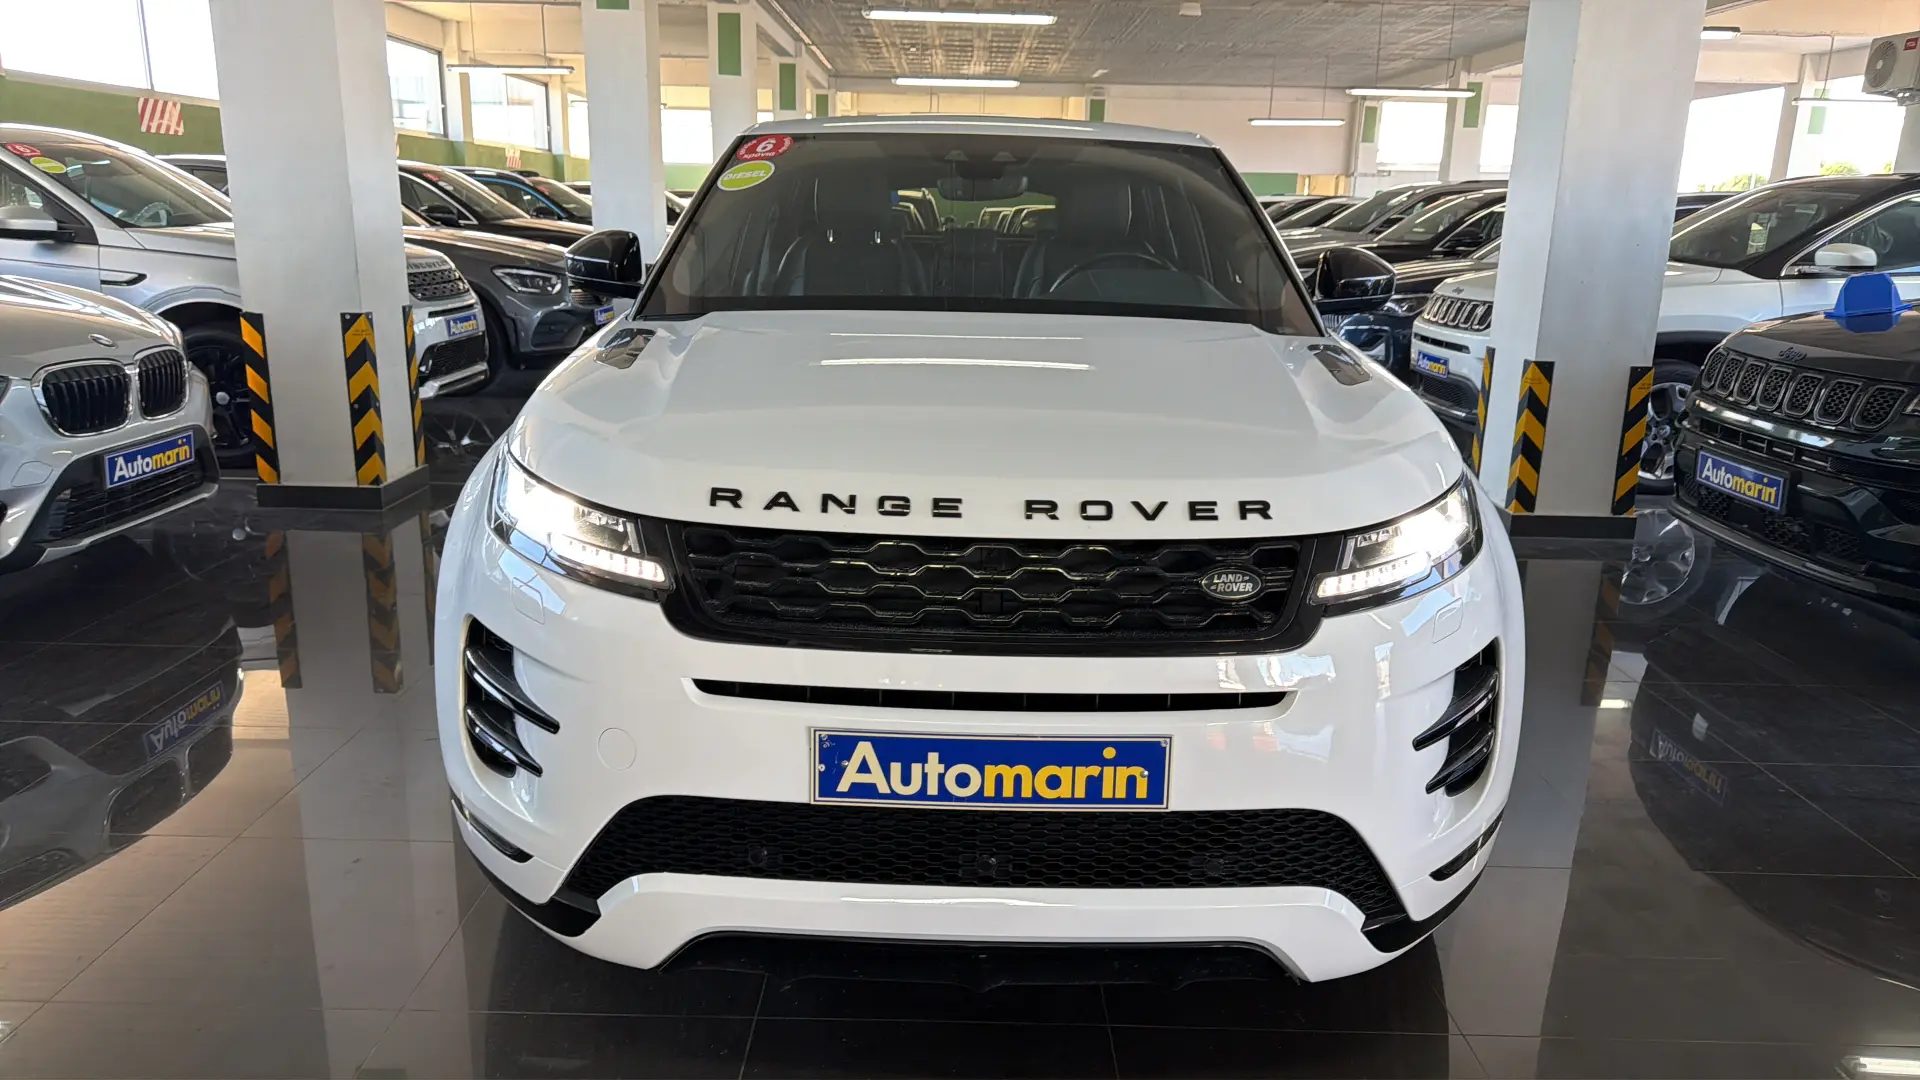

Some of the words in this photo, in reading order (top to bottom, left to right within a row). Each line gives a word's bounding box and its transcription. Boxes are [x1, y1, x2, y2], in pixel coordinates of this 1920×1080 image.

[756, 139, 776, 152] 6
[723, 170, 766, 180] DIESEL
[113, 439, 190, 482] Automarin
[1701, 457, 1777, 504] Automarin
[709, 487, 963, 518] RANGE
[1024, 499, 1273, 521] ROVER
[1213, 574, 1243, 583] LAND
[1216, 582, 1254, 592] ROVER
[836, 740, 1148, 799] Automarin
